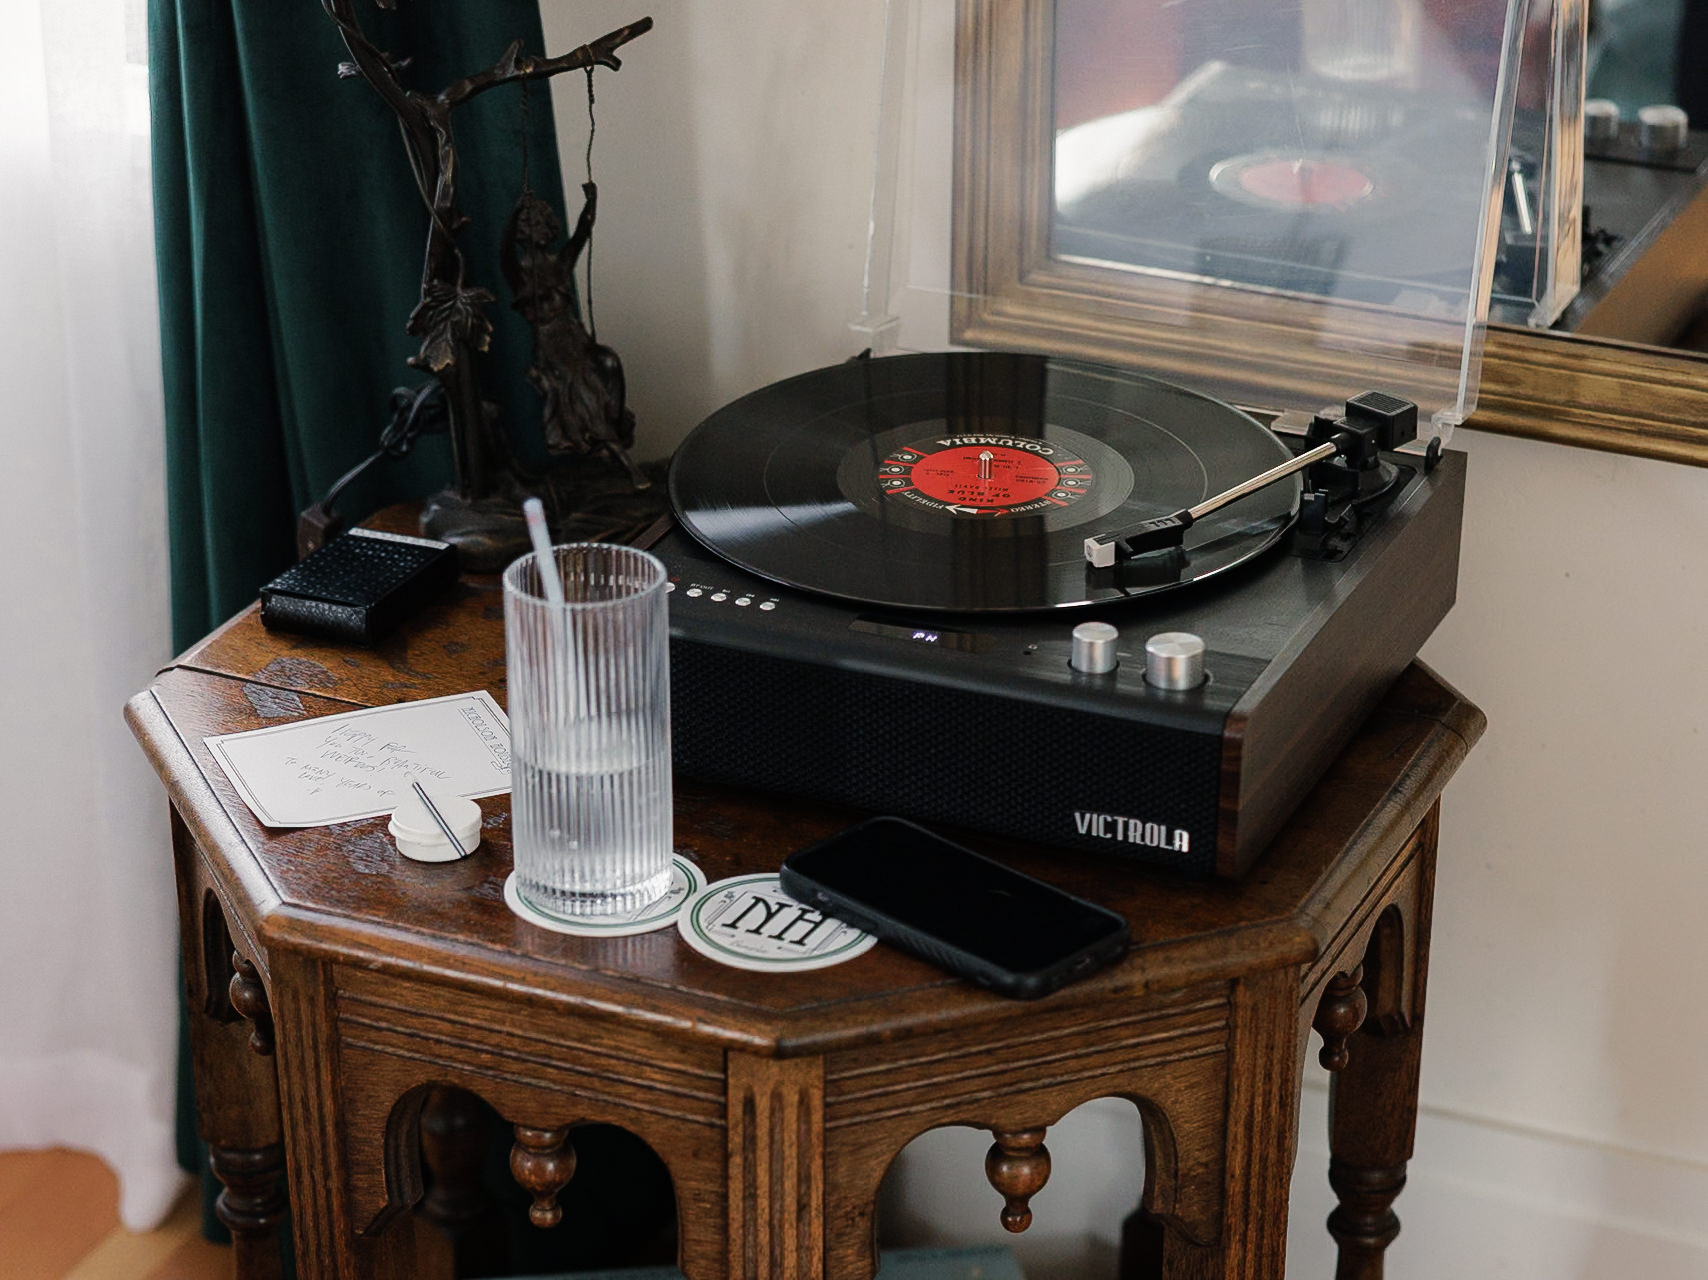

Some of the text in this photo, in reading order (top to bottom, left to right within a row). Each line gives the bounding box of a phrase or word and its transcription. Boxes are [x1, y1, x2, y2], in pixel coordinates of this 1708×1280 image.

[935, 437, 1054, 456] COLUMBIA
[902, 491, 945, 509] FIDELITY
[1010, 498, 1050, 513] STEREO
[1073, 810, 1190, 853] VICTROLA
[721, 895, 831, 947] NH
